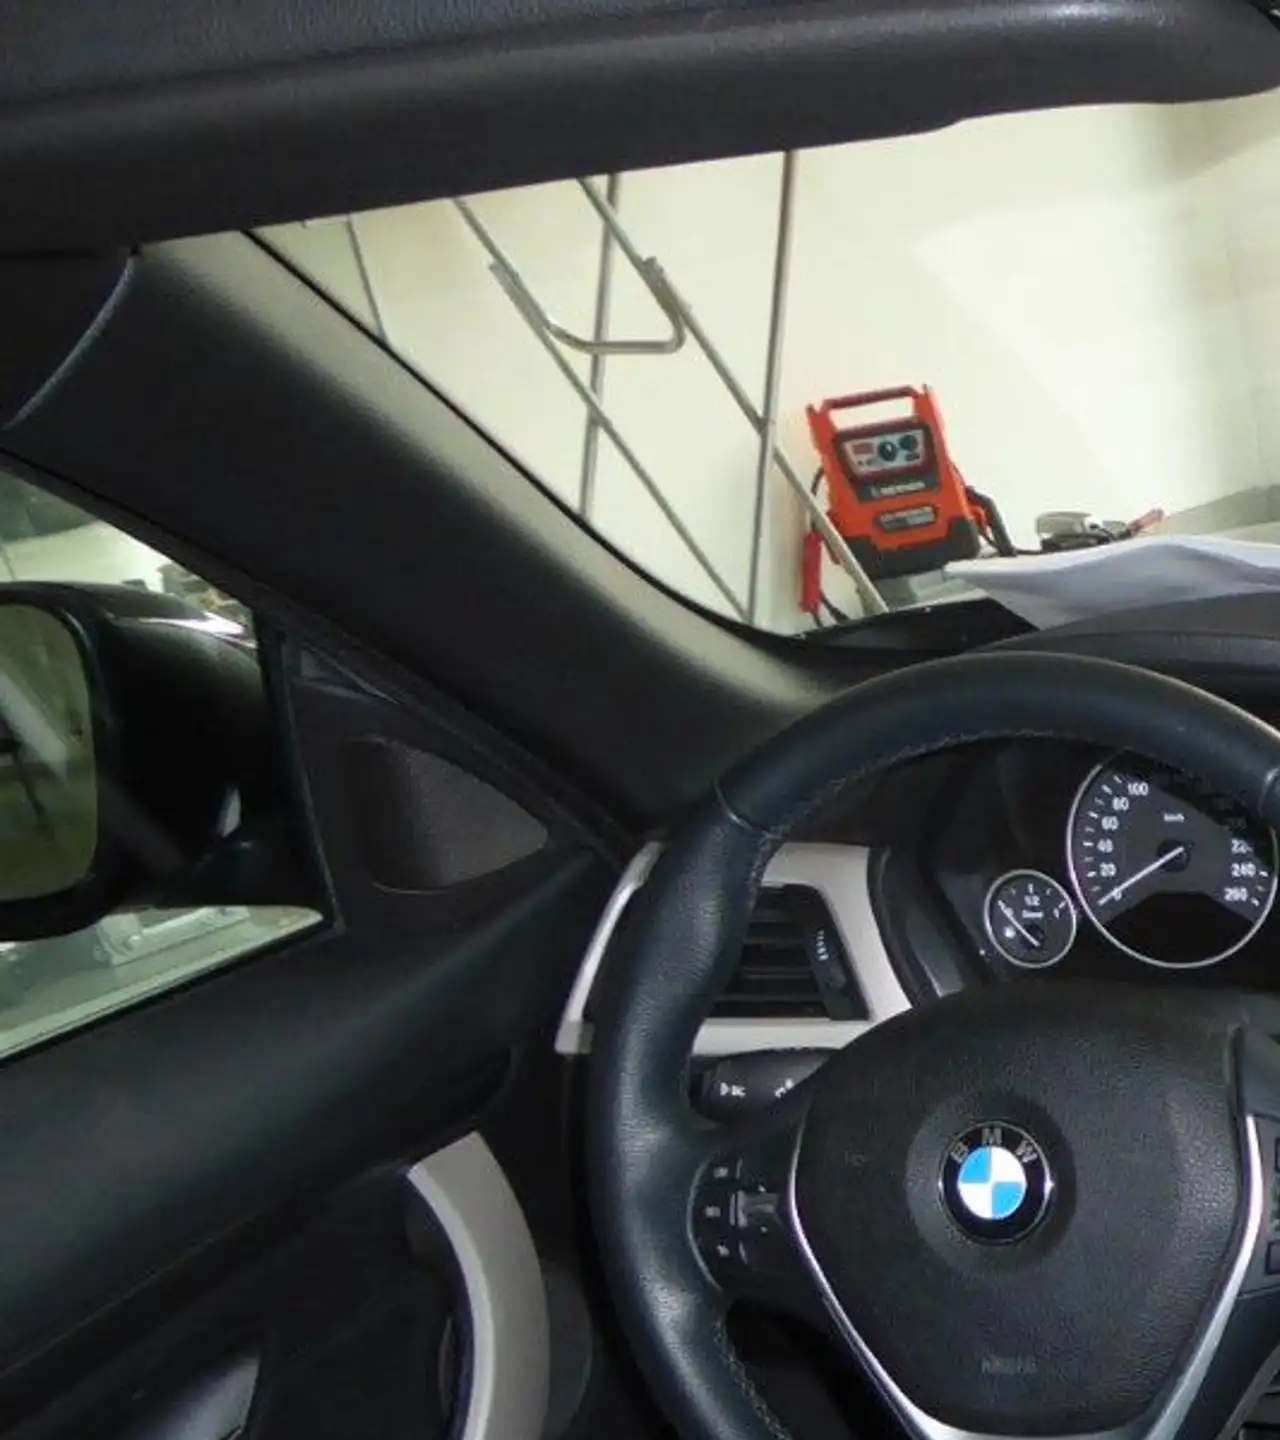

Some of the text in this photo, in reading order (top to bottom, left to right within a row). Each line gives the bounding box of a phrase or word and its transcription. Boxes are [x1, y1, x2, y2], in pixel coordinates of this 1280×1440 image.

[1127, 782, 1149, 796] 100
[1102, 816, 1119, 831] 60
[1100, 863, 1117, 877] 20
[949, 1127, 1039, 1164] BMW
